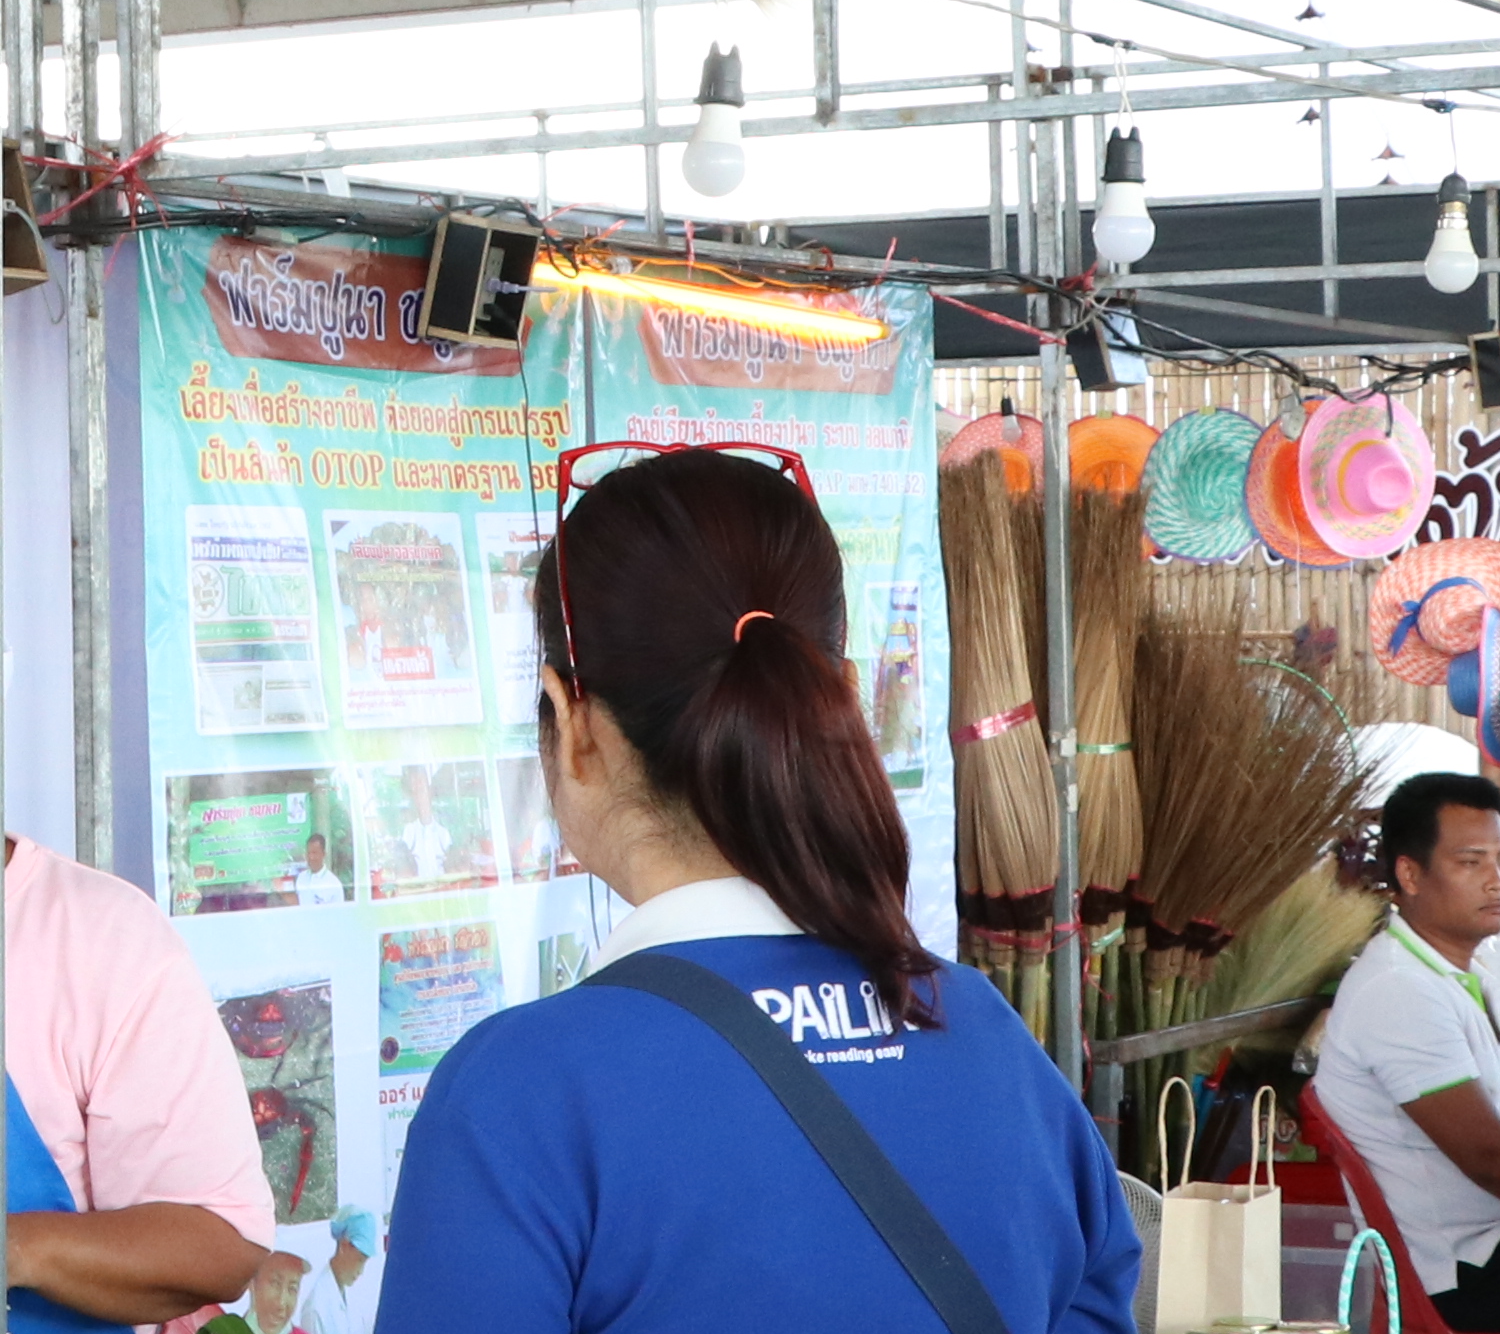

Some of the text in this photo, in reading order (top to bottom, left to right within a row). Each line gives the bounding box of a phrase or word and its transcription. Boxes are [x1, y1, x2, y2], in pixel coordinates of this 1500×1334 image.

[311, 449, 385, 489] OTOP
[826, 1047, 875, 1065] reading
[875, 1044, 905, 1061] easy
